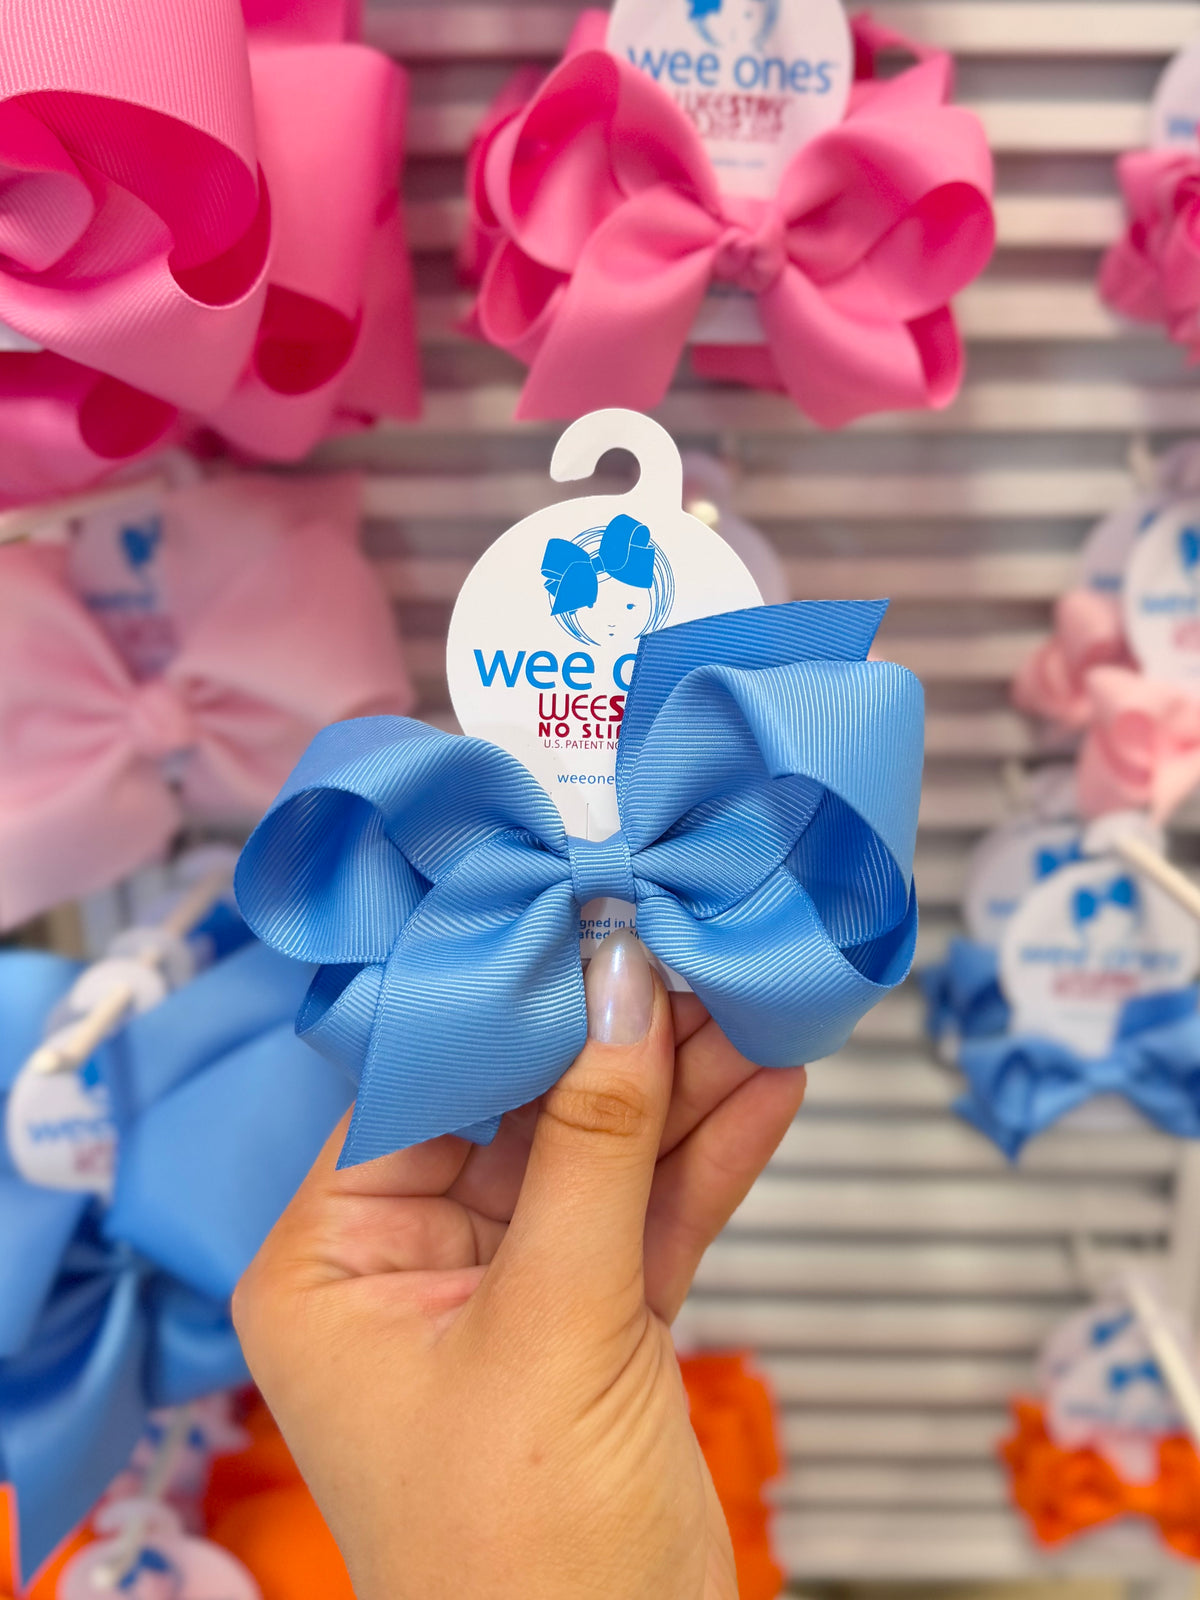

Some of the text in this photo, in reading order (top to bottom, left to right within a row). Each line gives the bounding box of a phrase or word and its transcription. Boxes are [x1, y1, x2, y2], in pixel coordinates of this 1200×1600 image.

[733, 55, 832, 94] ones
[473, 649, 595, 691] wee
[538, 692, 626, 722] WEES
[538, 721, 570, 738] NO
[543, 739, 563, 749] U.S.
[565, 740, 605, 750] PATENT
[557, 774, 615, 785] weeone
[579, 917, 611, 929] gned
[614, 918, 626, 929] in
